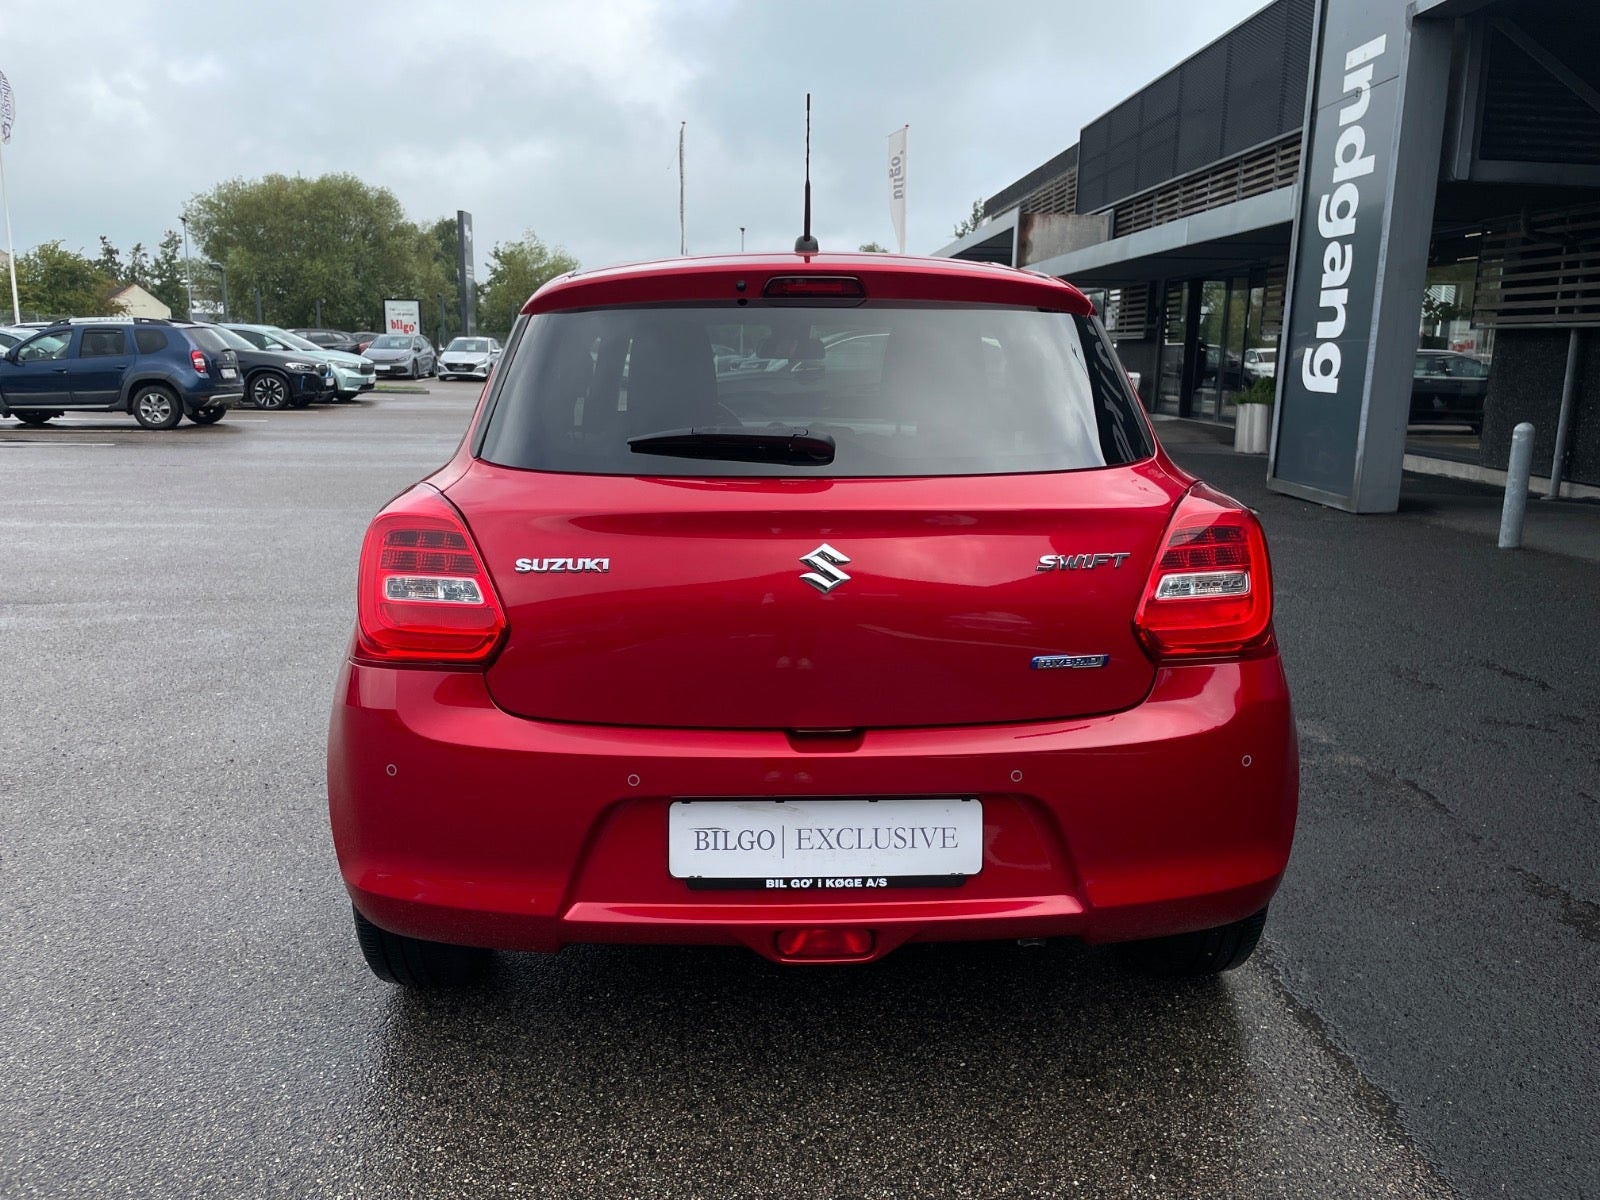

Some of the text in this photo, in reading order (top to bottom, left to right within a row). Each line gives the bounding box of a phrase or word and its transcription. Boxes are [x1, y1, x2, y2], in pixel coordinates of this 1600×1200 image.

[1302, 33, 1387, 394] Indgang
[514, 557, 610, 573] SUZUKI
[1036, 552, 1131, 571] SWIFT
[1040, 656, 1100, 668] HYBRID
[694, 826, 959, 851] BILGO EXCLUSIVE
[766, 879, 789, 888] BIL
[826, 878, 863, 888] KØGE
[866, 877, 888, 888] A/S
